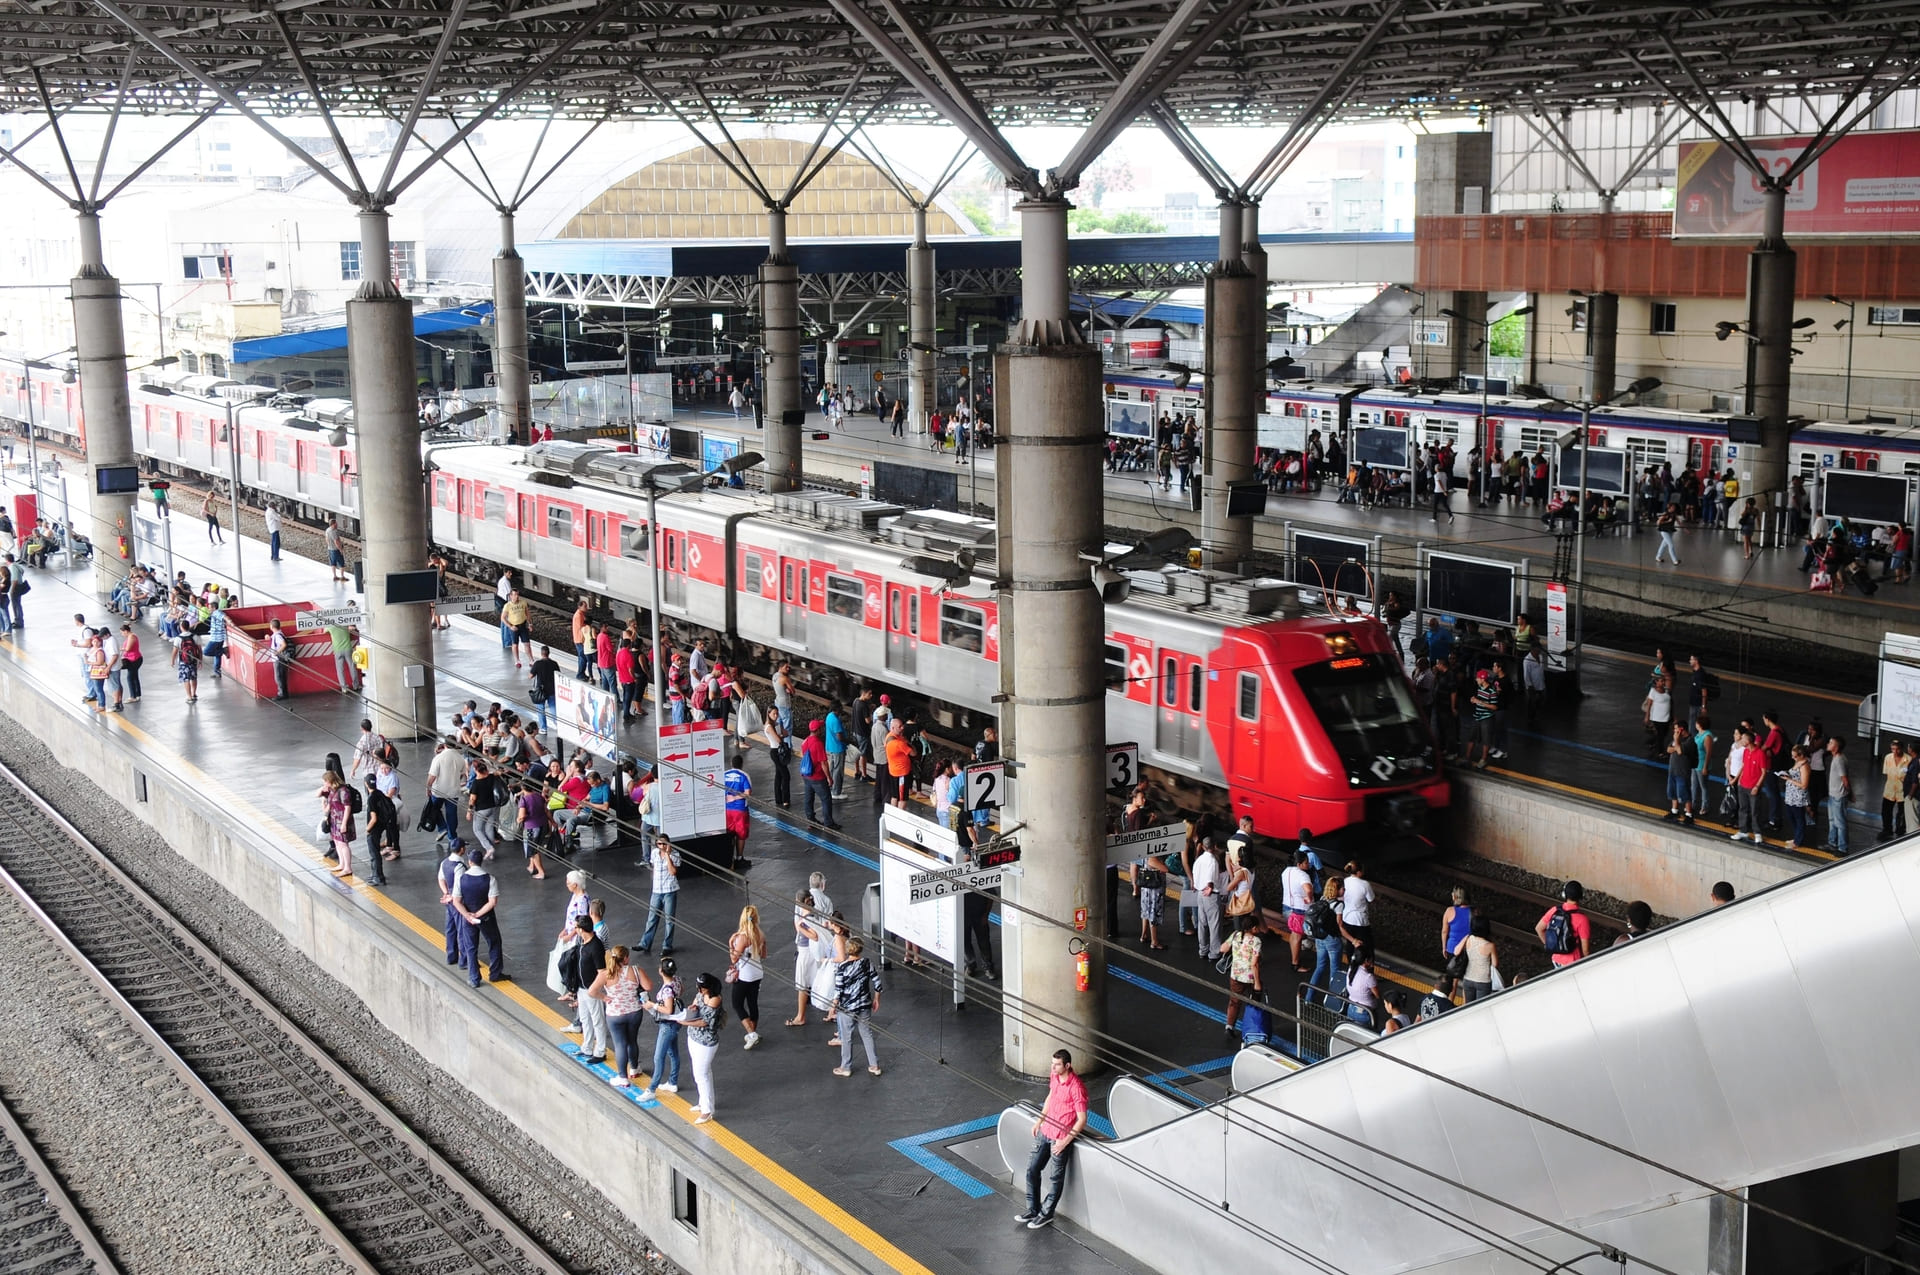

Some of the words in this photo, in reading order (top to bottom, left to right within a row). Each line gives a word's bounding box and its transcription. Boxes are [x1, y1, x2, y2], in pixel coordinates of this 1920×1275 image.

[900, 349, 907, 360] 6
[488, 375, 495, 387] 4
[532, 373, 540, 385] 5
[441, 596, 476, 604] Plataforma
[316, 607, 354, 617] Plataforma
[465, 603, 481, 612] Luz
[298, 620, 313, 629] Rio
[338, 615, 361, 625] Serra
[968, 763, 1004, 773] PLATAFORMA
[1111, 752, 1131, 788] 3
[673, 779, 682, 793] 2
[706, 773, 714, 787] 3
[975, 772, 996, 809] 2
[1114, 829, 1161, 844] Plataforma
[1163, 826, 1169, 836] 3
[1146, 842, 1168, 855] Luz
[911, 866, 963, 884] Plataforma
[965, 864, 972, 875] 2
[911, 888, 931, 901] Rio
[935, 883, 948, 895] G.
[970, 873, 1002, 888] Serra
